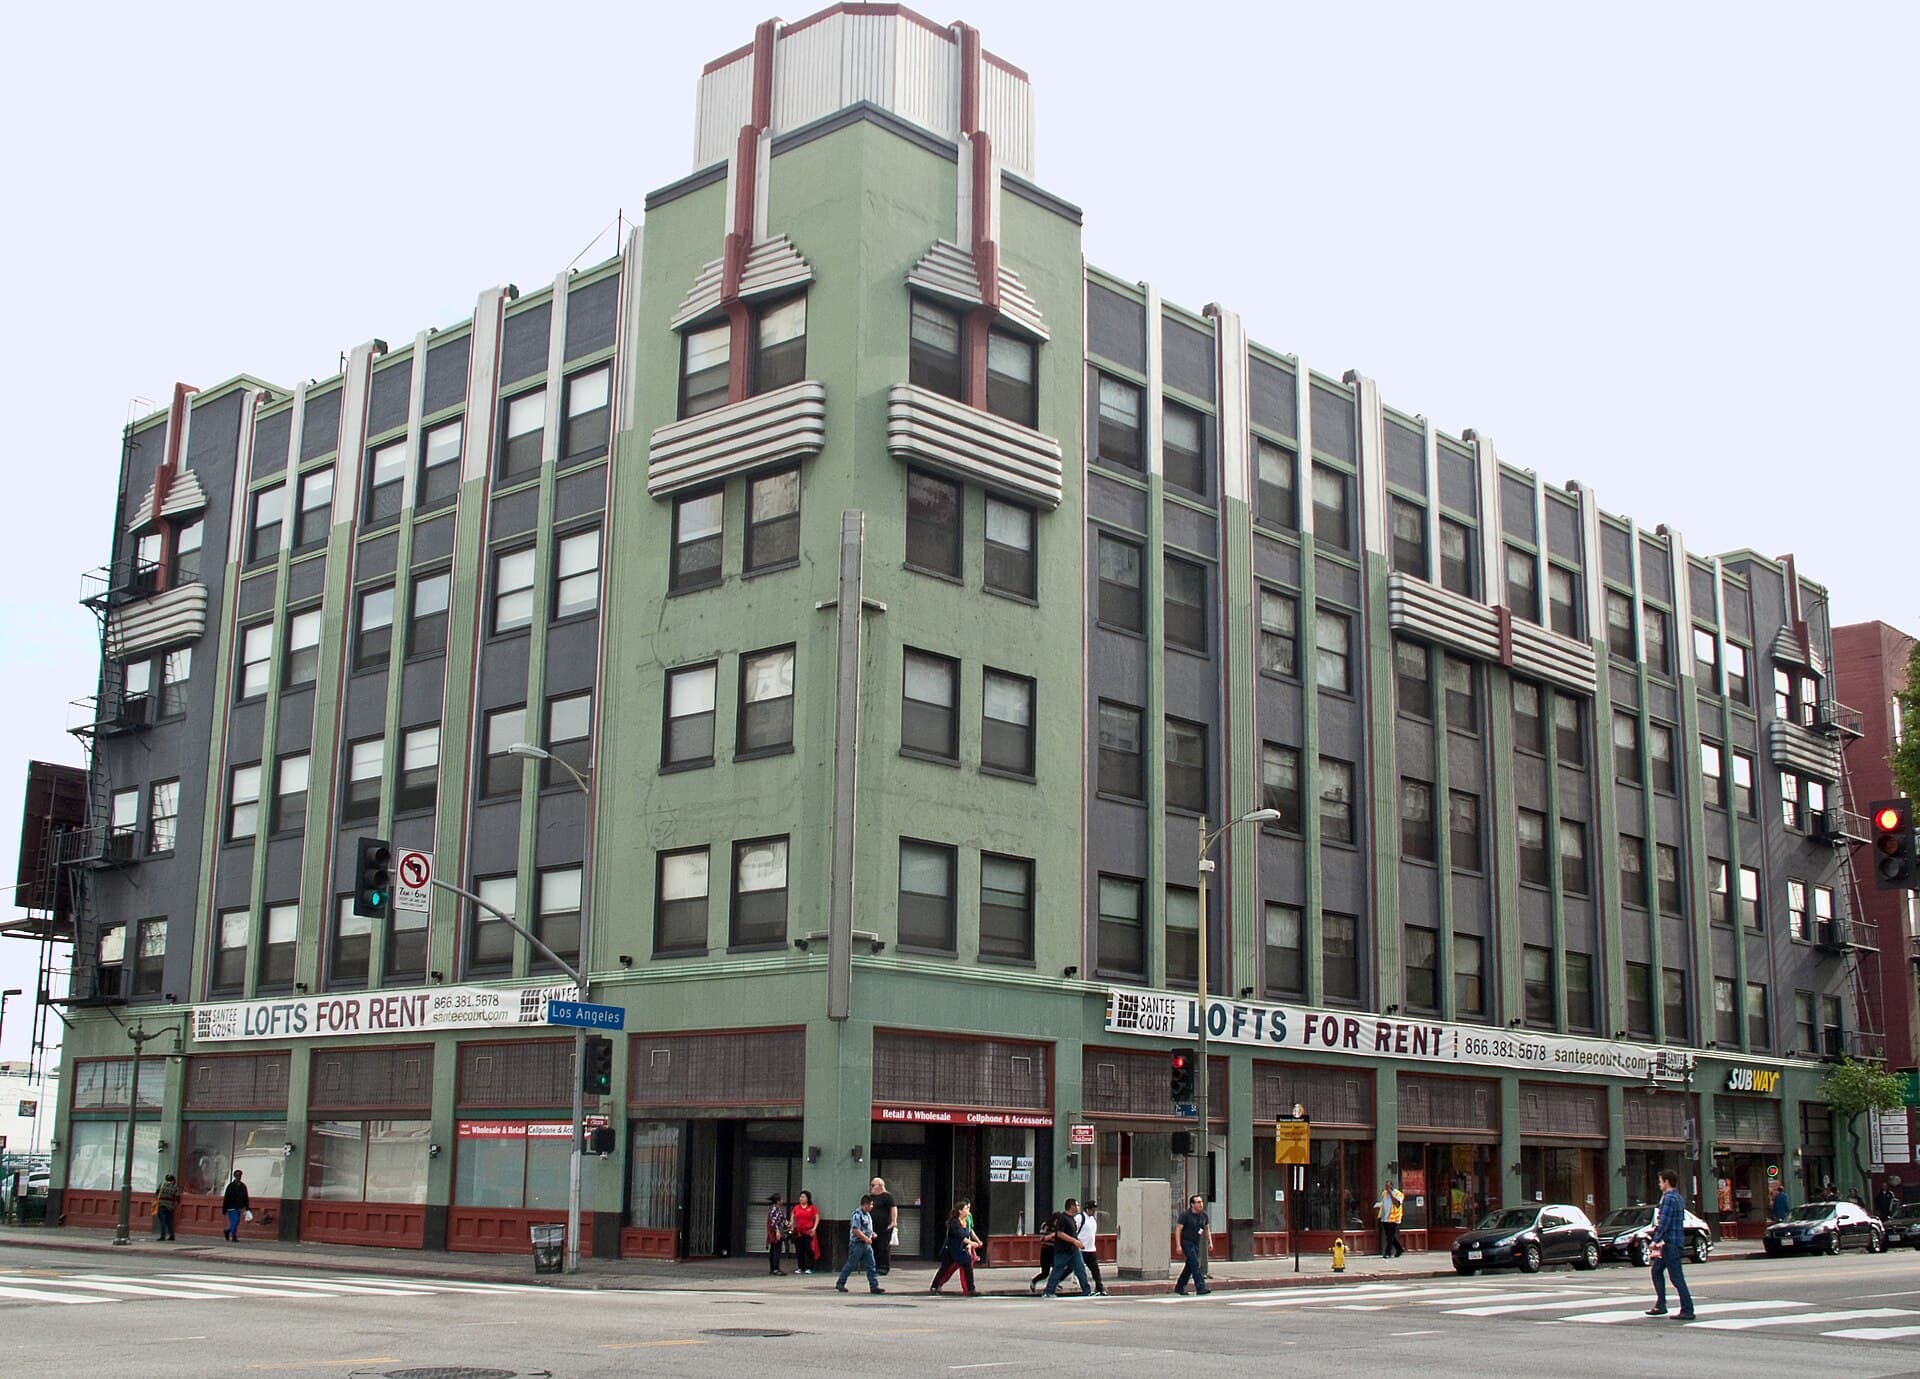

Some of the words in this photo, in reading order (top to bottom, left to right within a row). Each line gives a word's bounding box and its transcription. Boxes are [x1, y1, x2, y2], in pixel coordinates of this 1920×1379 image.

[434, 994, 499, 1010] 866.381.5678
[1140, 996, 1176, 1014] SANTEE
[212, 1008, 238, 1022] SANTEE
[244, 1003, 308, 1036] LOFTS
[316, 1000, 361, 1032] FOR
[368, 994, 431, 1029] RENT
[432, 1009, 509, 1024] santeecourt.com
[552, 1005, 572, 1019] Los
[576, 1006, 620, 1024] Angeles
[211, 1023, 237, 1038] COURT
[1139, 1014, 1175, 1032] COURT
[1188, 1001, 1287, 1042] LOFTS
[1303, 1014, 1360, 1049] FOR
[1375, 1022, 1443, 1056] RENT
[1465, 1037, 1546, 1062] 866.381.5678
[1554, 1048, 1647, 1070] santeecourt.com
[1667, 1052, 1686, 1065] SANTE
[1728, 1067, 1780, 1092] SUBWAY
[883, 1109, 905, 1119] Retail
[907, 1110, 913, 1119] &
[914, 1110, 951, 1121] Wholesale
[967, 1113, 1003, 1124] Cellphone
[1004, 1115, 1010, 1123] &
[1012, 1115, 1053, 1125] Accessories
[471, 1126, 500, 1134] Wholesale
[502, 1126, 507, 1134] &
[508, 1126, 526, 1134] Retail
[528, 1126, 557, 1135] Cellphone
[557, 1126, 562, 1134] &
[990, 1159, 1012, 1167] MOVING
